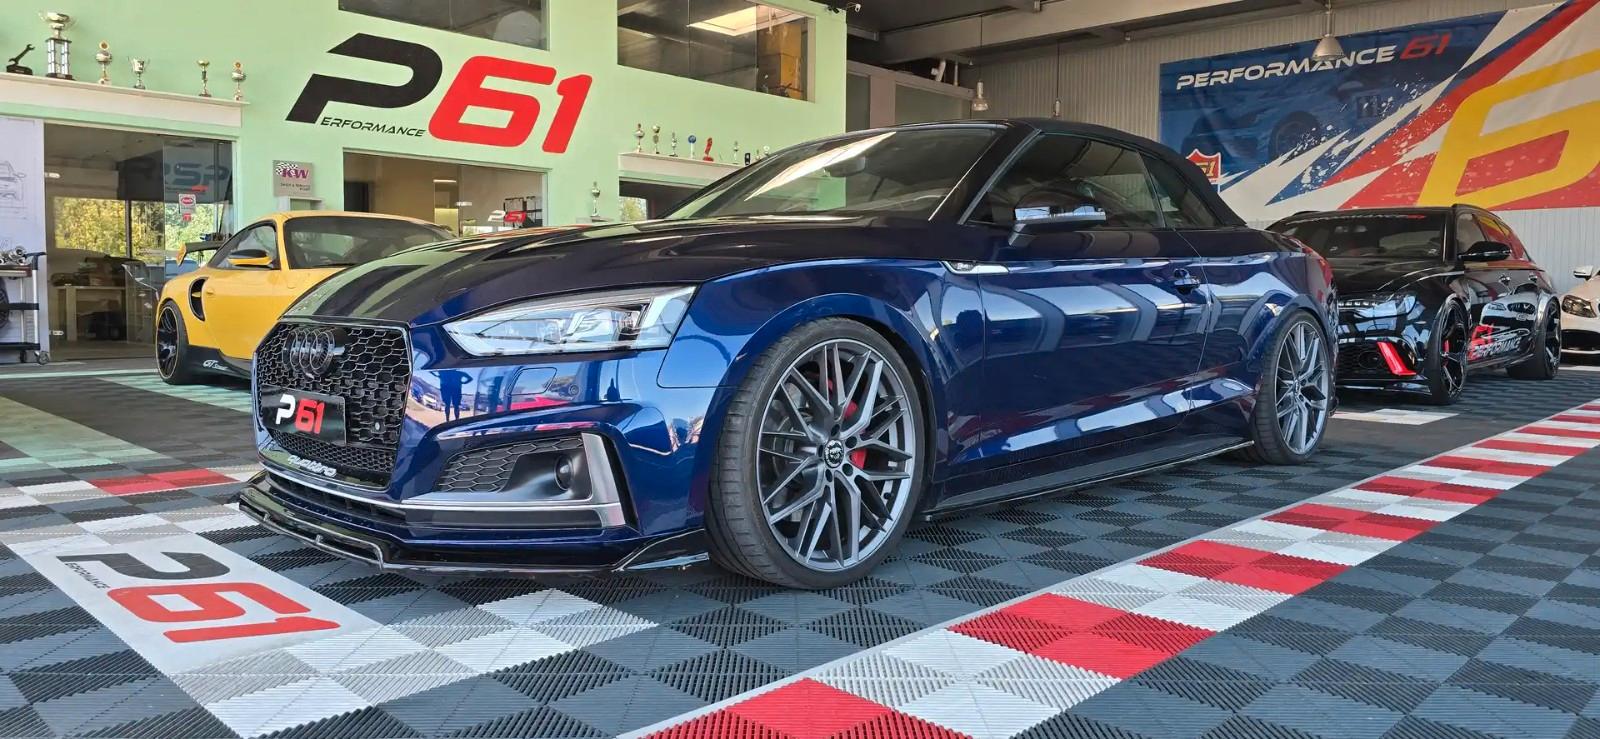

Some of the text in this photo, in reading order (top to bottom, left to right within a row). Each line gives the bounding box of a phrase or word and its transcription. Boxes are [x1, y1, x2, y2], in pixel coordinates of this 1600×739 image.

[1176, 33, 1452, 90] PERFORMANCE 61
[285, 33, 593, 154] P61
[320, 116, 426, 137] ERFORMANCE
[282, 168, 309, 179] KW
[275, 393, 326, 436] P61
[287, 454, 337, 478] quattro
[56, 551, 341, 643] P61
